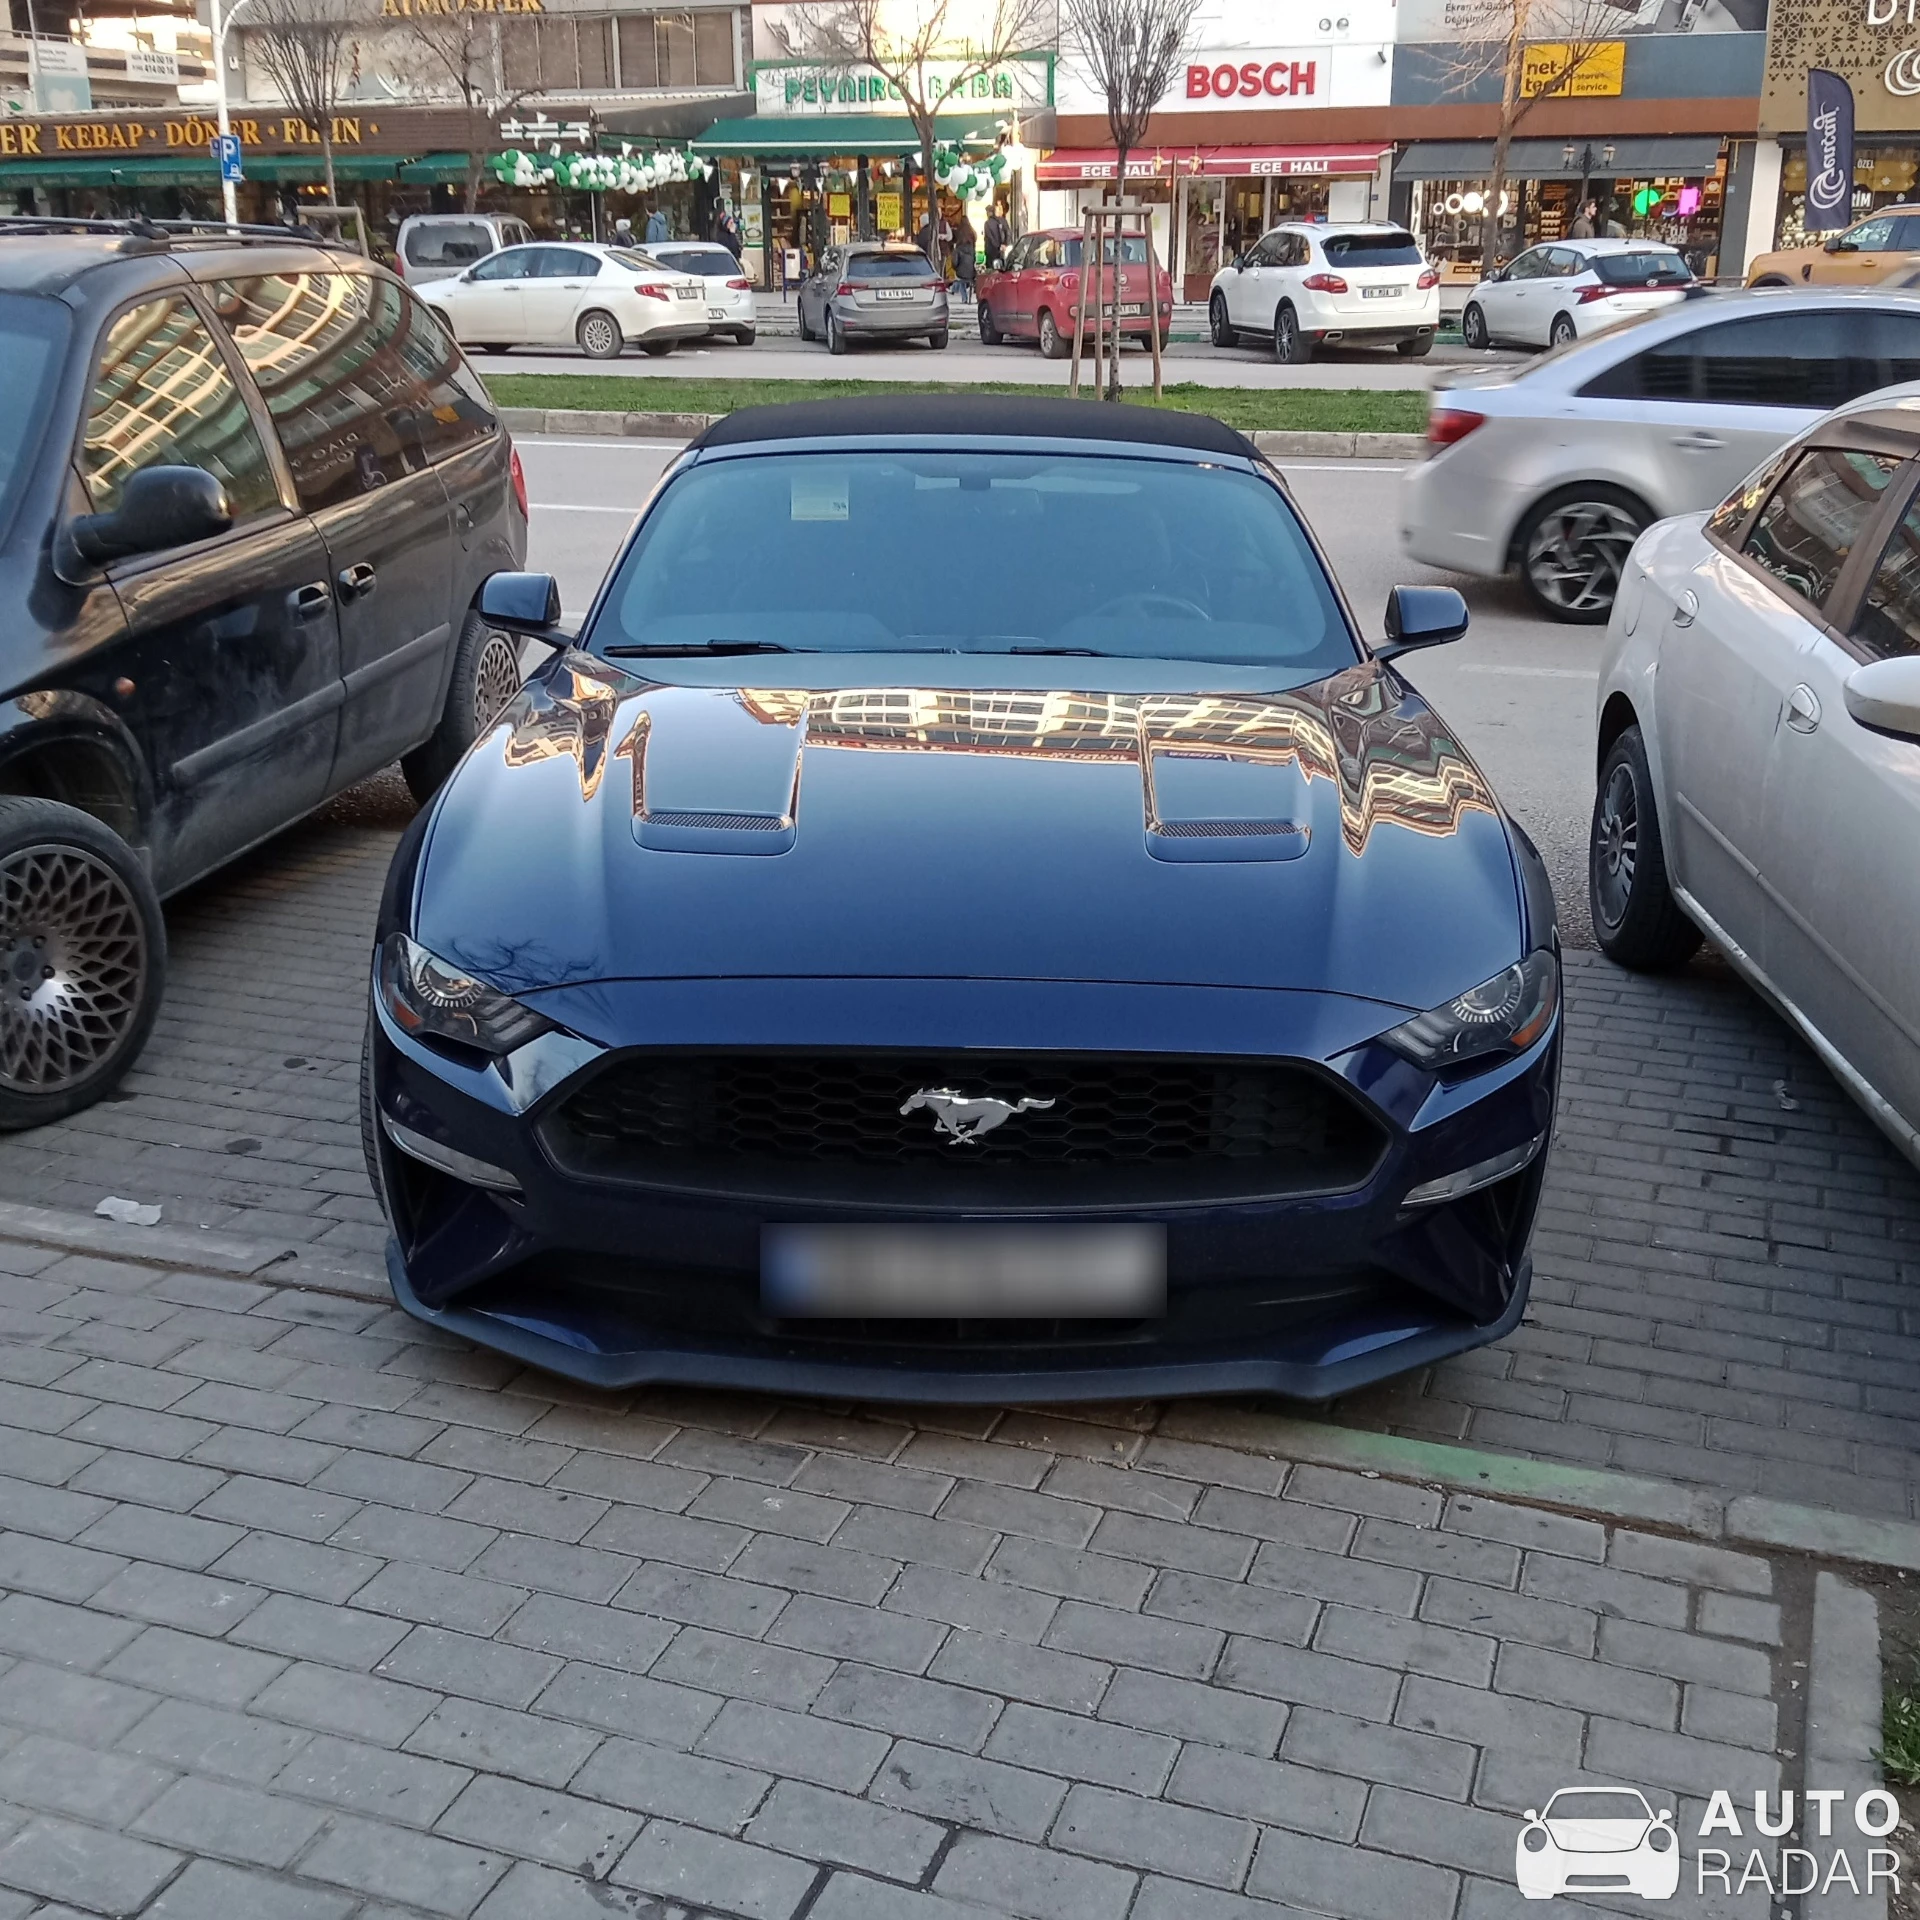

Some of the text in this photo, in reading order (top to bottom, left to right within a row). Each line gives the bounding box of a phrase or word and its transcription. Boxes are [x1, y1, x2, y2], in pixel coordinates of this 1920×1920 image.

[1186, 61, 1316, 98] BOSCH
[55, 123, 144, 149] KEBAP
[222, 138, 236, 164] P
[1081, 166, 1111, 177] ECE
[1250, 160, 1329, 174] ECE HALI
[1857, 156, 1875, 169] ÖZEL
